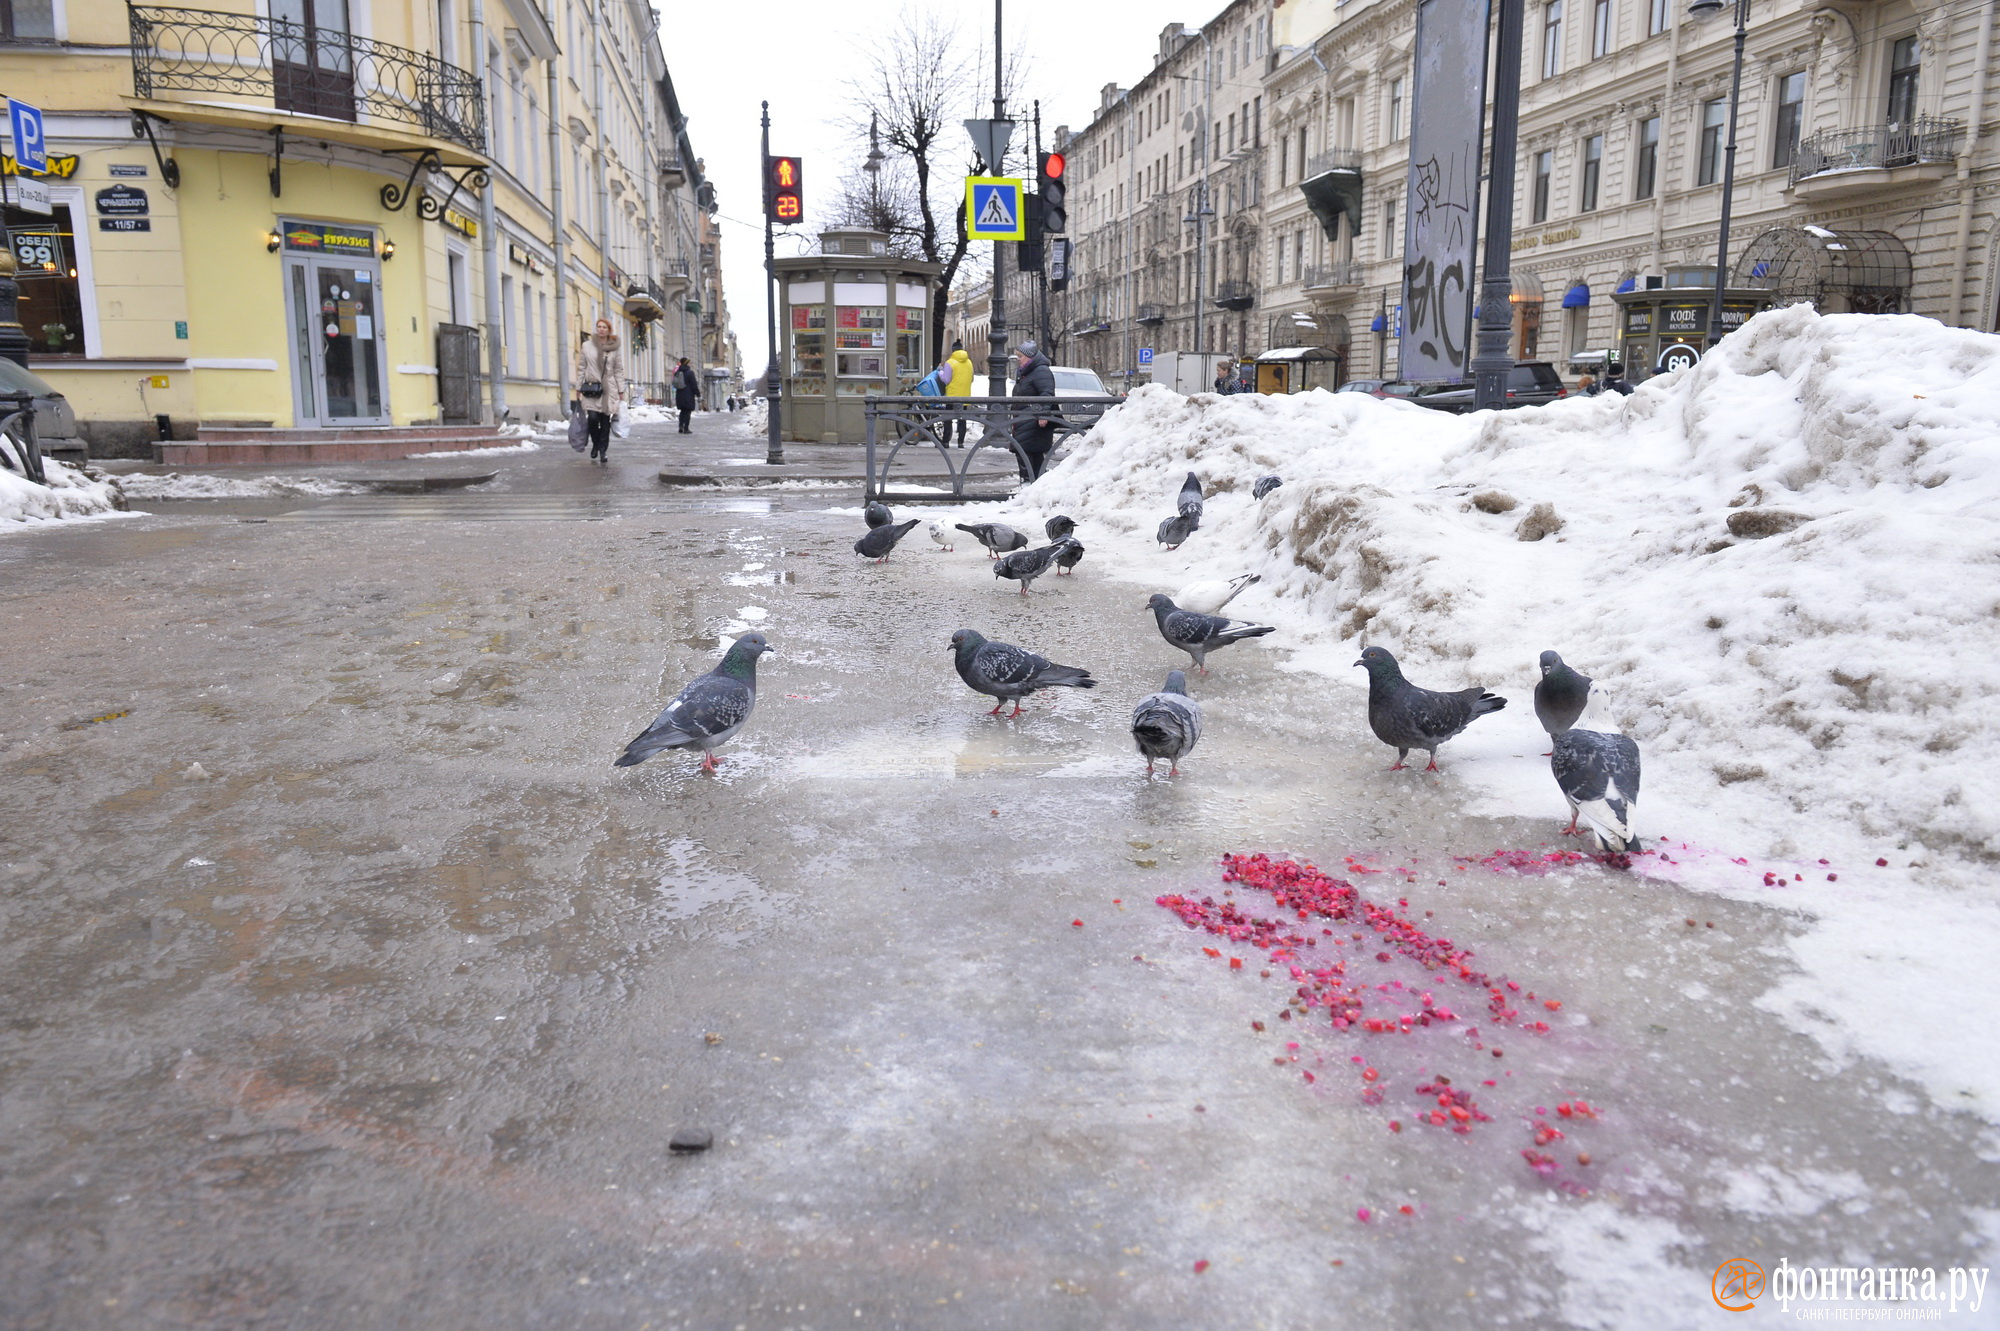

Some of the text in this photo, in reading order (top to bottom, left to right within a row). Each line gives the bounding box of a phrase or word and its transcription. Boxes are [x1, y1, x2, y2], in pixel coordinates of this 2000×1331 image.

[777, 196, 799, 217] 23
[114, 220, 136, 230] 11/57
[16, 236, 52, 247] ОБЕД
[323, 234, 369, 248] ЕВРАЗИЯ
[19, 246, 52, 264] 99
[1670, 309, 1697, 322] КОФЕ
